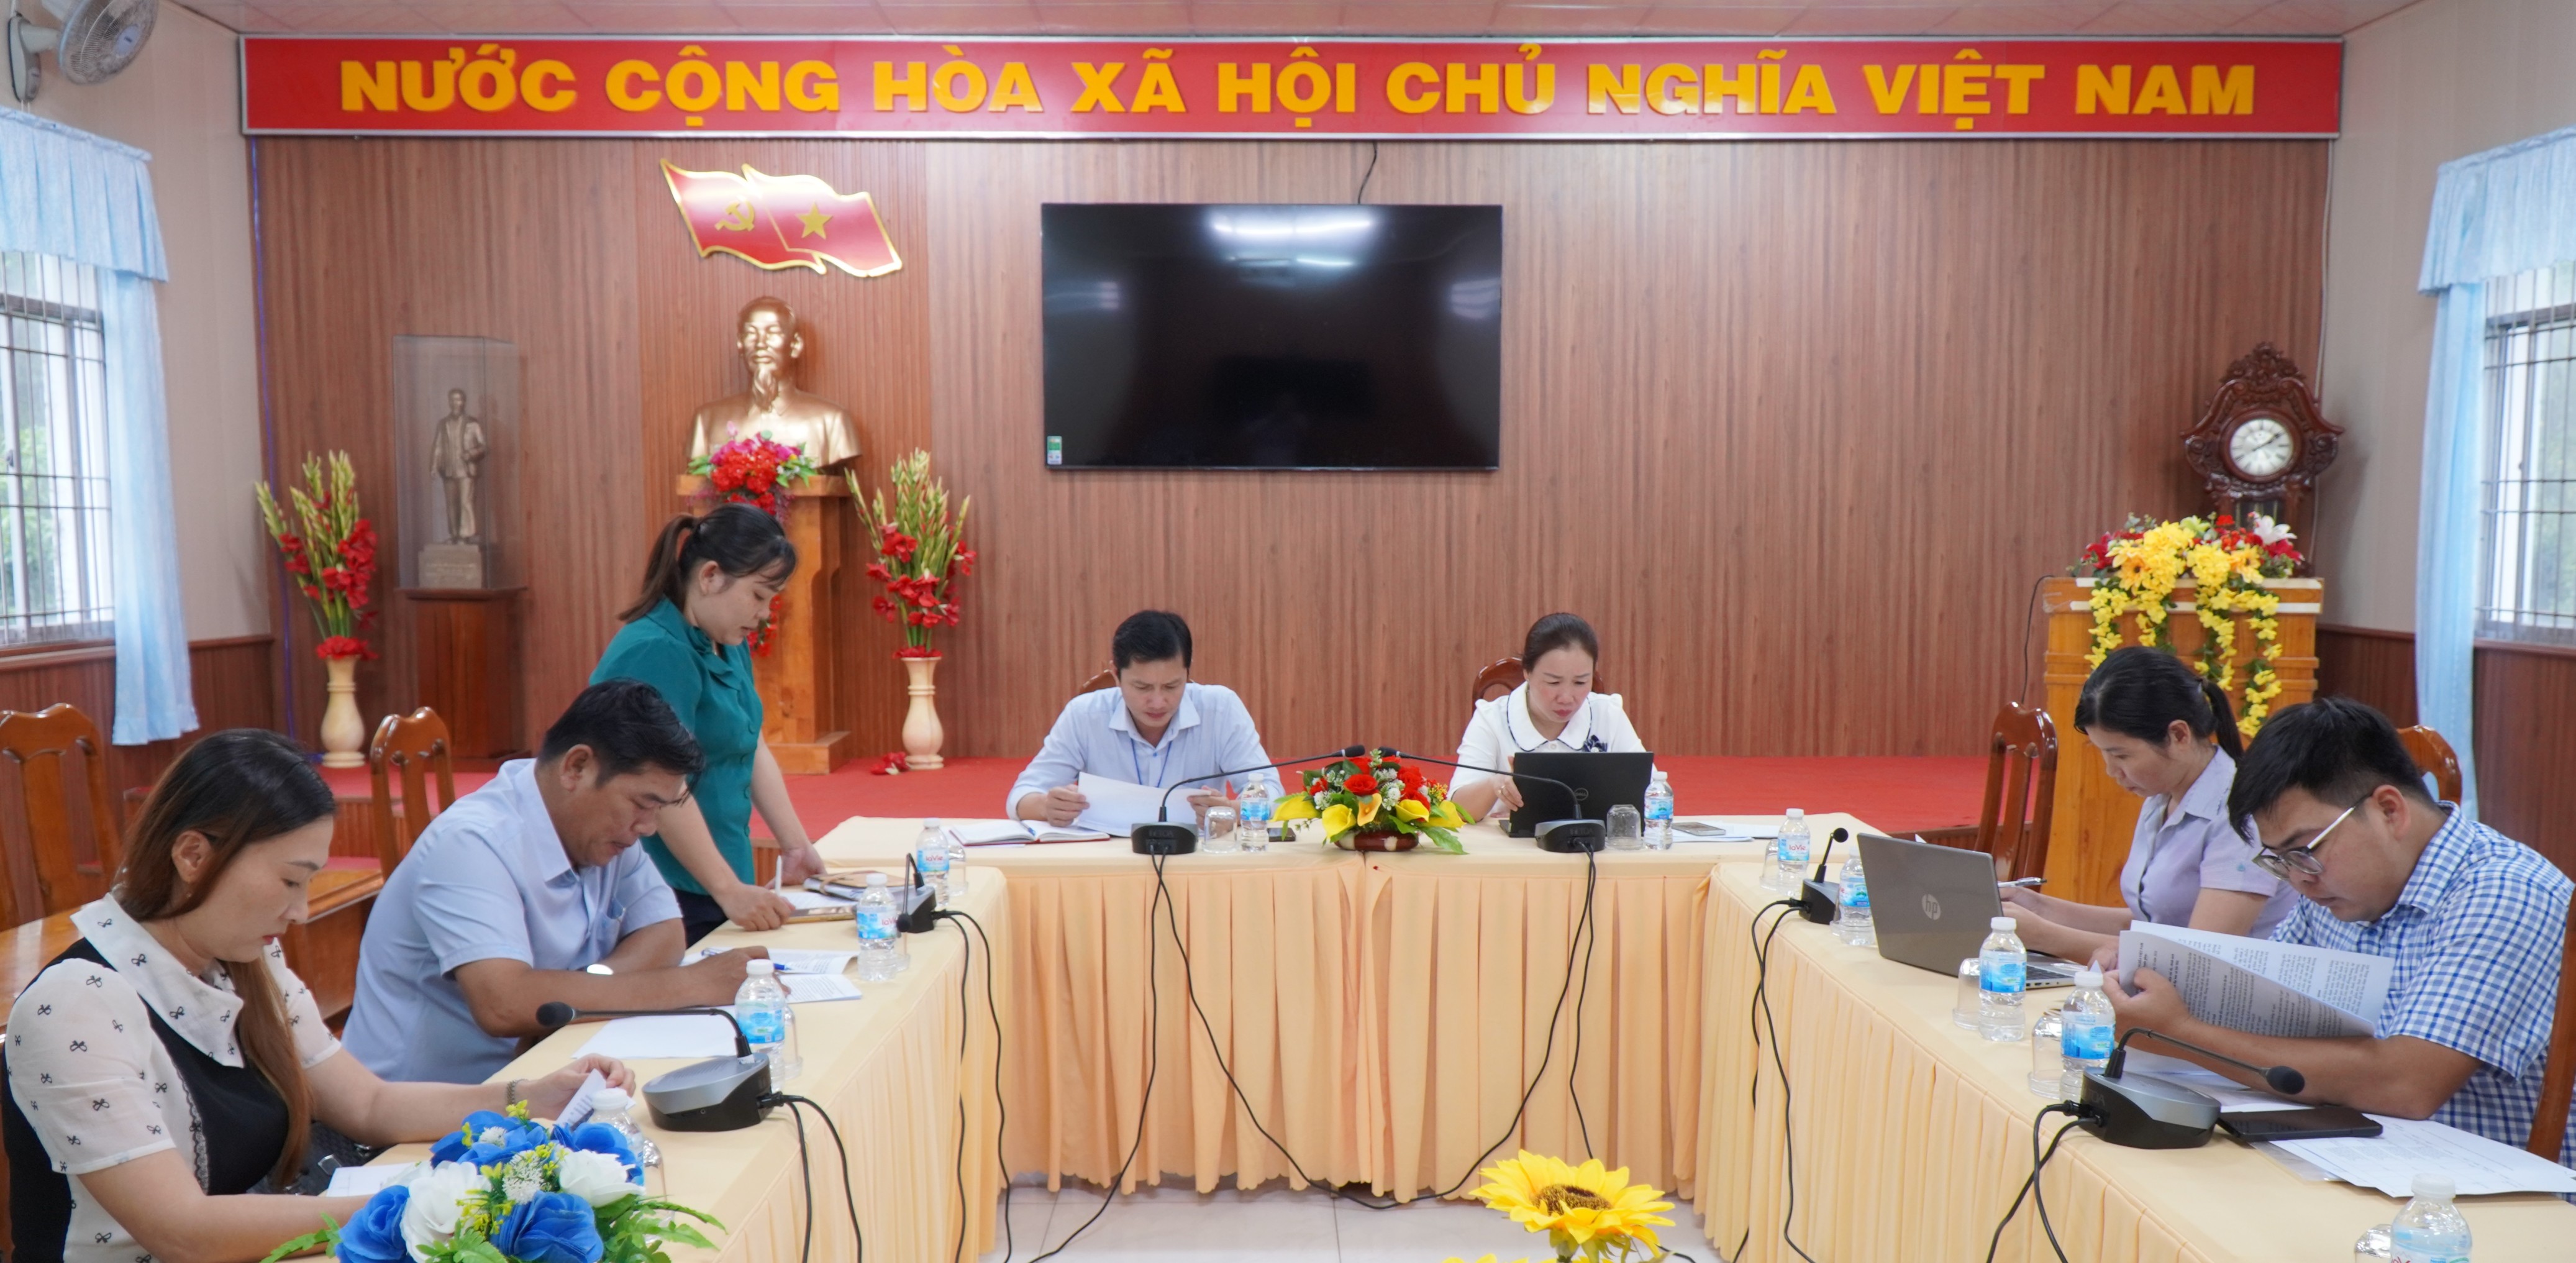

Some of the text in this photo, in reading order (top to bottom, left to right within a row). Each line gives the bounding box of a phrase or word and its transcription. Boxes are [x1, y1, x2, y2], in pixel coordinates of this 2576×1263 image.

[341, 43, 2255, 130] NƯỚC CỘNG HÒA XÃ HỘI CHỦ NGHĨA VIỆT NAM
